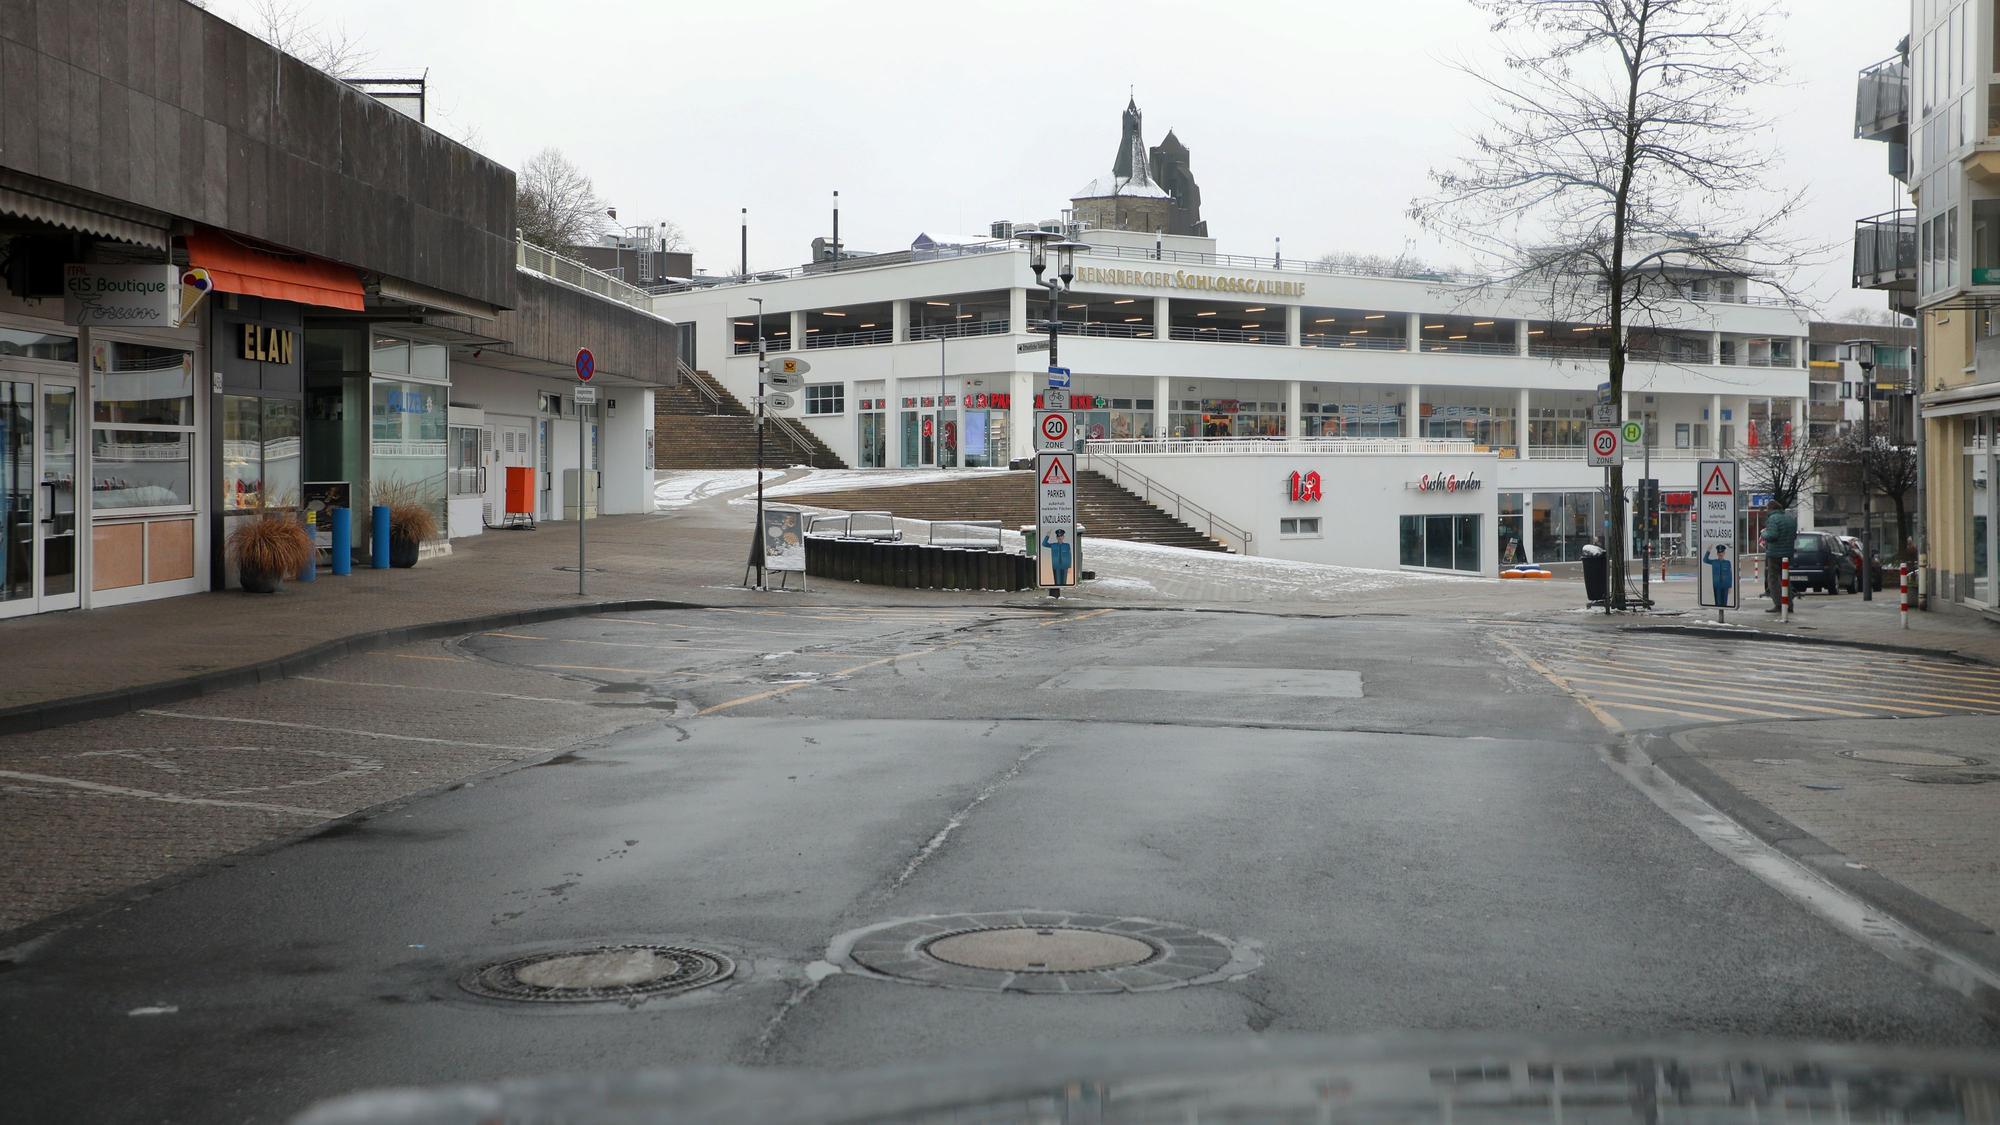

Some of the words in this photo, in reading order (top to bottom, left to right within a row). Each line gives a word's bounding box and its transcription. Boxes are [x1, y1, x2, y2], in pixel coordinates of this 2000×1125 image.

[67, 277, 93, 292] EIS
[97, 278, 166, 296] Boutique
[1175, 270, 1306, 296] SCHLOSSGALERIE
[244, 323, 293, 365] ELAN
[1048, 421, 1063, 434] 20
[1627, 427, 1636, 438] H
[1045, 441, 1065, 449] ZONE
[1599, 437, 1612, 449] 20
[1596, 456, 1615, 464] ZONE
[1418, 471, 1446, 493] Sushi
[1447, 471, 1481, 493] Garden
[1047, 489, 1066, 498] PARKEN
[1708, 501, 1727, 510] PARKEN
[1042, 513, 1071, 524] UNZULÄSSIG
[1704, 527, 1732, 538] UNZULÄSSIG
